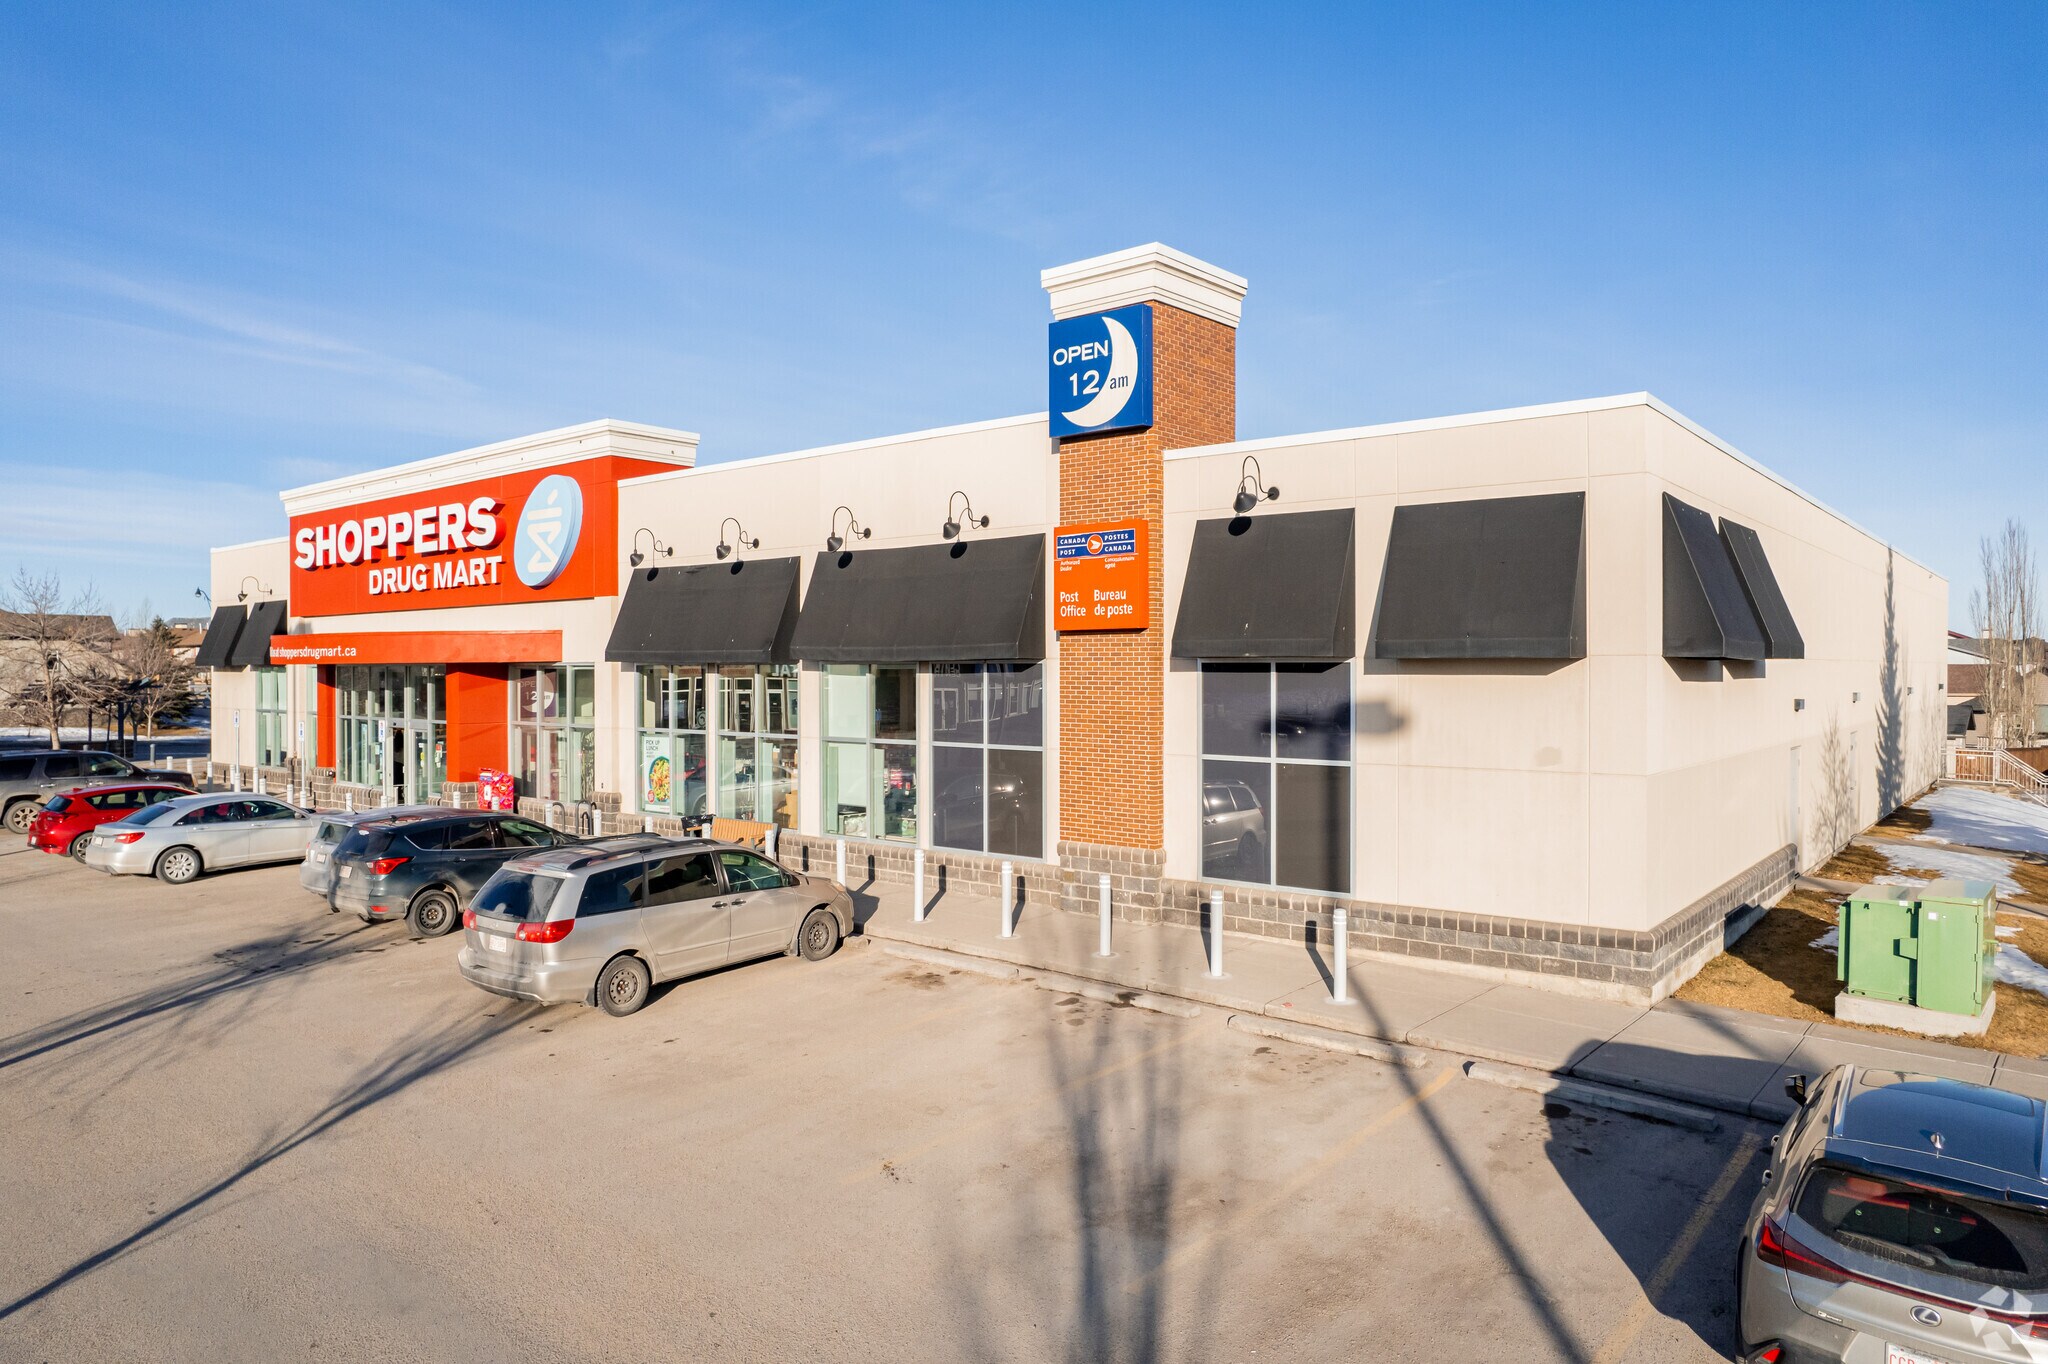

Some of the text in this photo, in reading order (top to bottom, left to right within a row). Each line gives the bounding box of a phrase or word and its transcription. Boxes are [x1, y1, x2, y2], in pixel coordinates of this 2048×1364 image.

[1052, 340, 1109, 366] OPEN
[1069, 370, 1129, 396] 12 am
[294, 497, 497, 569] SHOPPERS
[1060, 533, 1129, 545] CANADA POSTES
[1104, 544, 1132, 552] CANADA
[368, 555, 503, 595] DRUG MART
[1060, 591, 1079, 603] Post
[1094, 589, 1127, 601] Bureau
[1060, 605, 1086, 617] Office
[1094, 604, 1133, 619] de poste
[280, 645, 357, 660] shoppersdrugmart.ca
